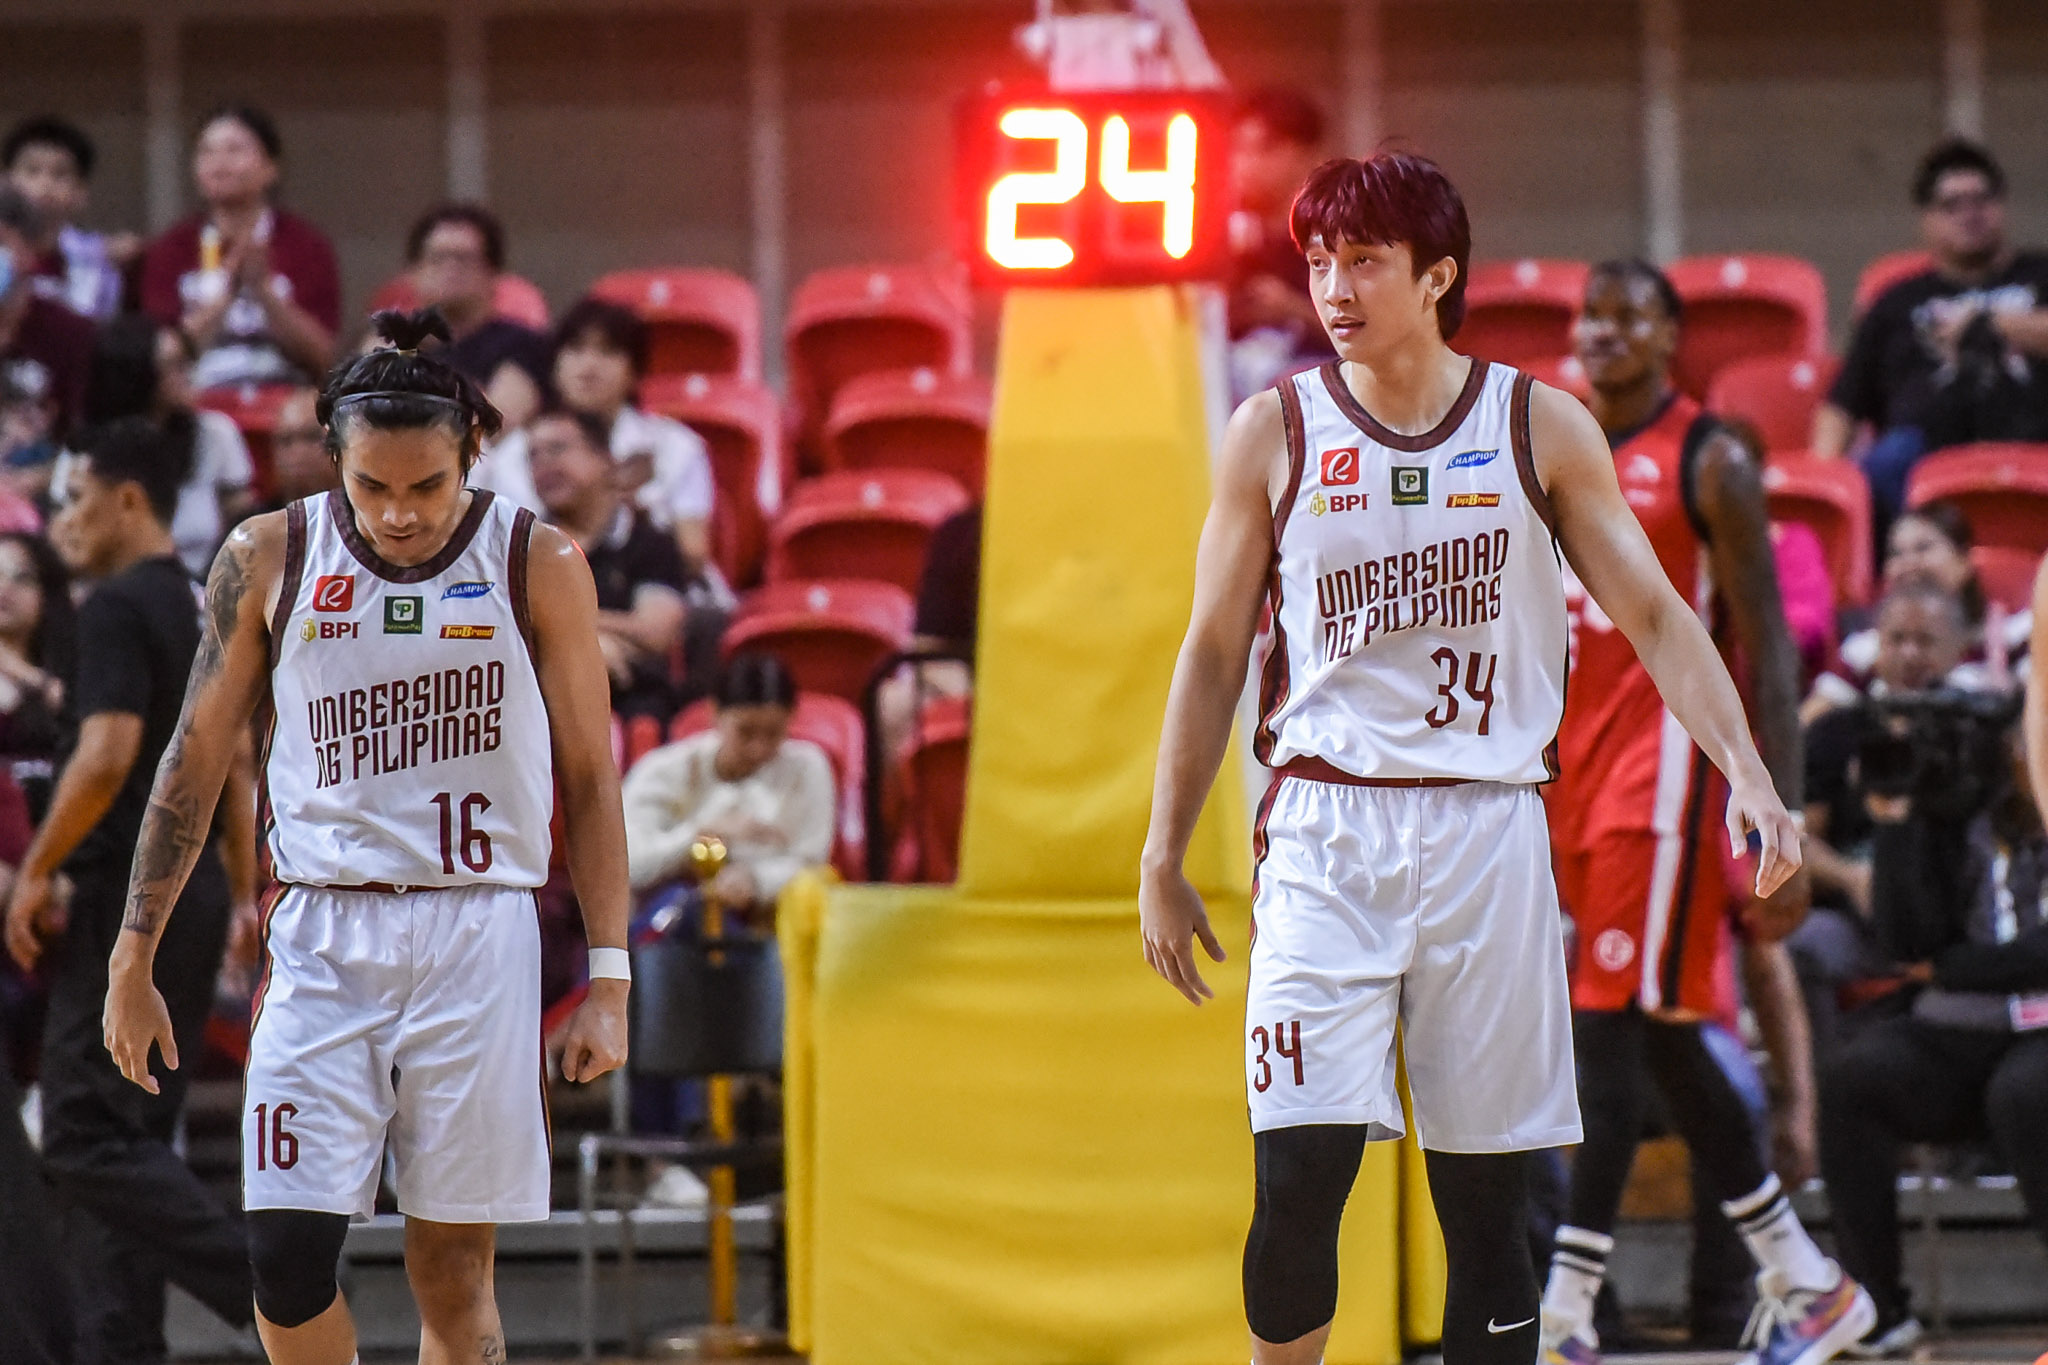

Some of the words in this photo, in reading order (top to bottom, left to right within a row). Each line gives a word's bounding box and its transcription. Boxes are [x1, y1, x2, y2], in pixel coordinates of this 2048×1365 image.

[986, 108, 1197, 269] 24
[1449, 451, 1496, 467] CHAMPION
[1330, 494, 1368, 512] BPI
[1316, 527, 1510, 619] UNIBERSIDAD
[320, 621, 358, 639] BPI
[1323, 614, 1356, 664] NG
[1364, 573, 1501, 647] PILIPINAS
[308, 660, 505, 743] UNIBERSIDAD
[1424, 646, 1498, 736] 34
[315, 740, 341, 789] NG
[352, 706, 501, 780] PILIPINAS
[429, 792, 493, 875] 16
[1250, 1020, 1305, 1093] 34
[252, 1102, 300, 1171] 16
